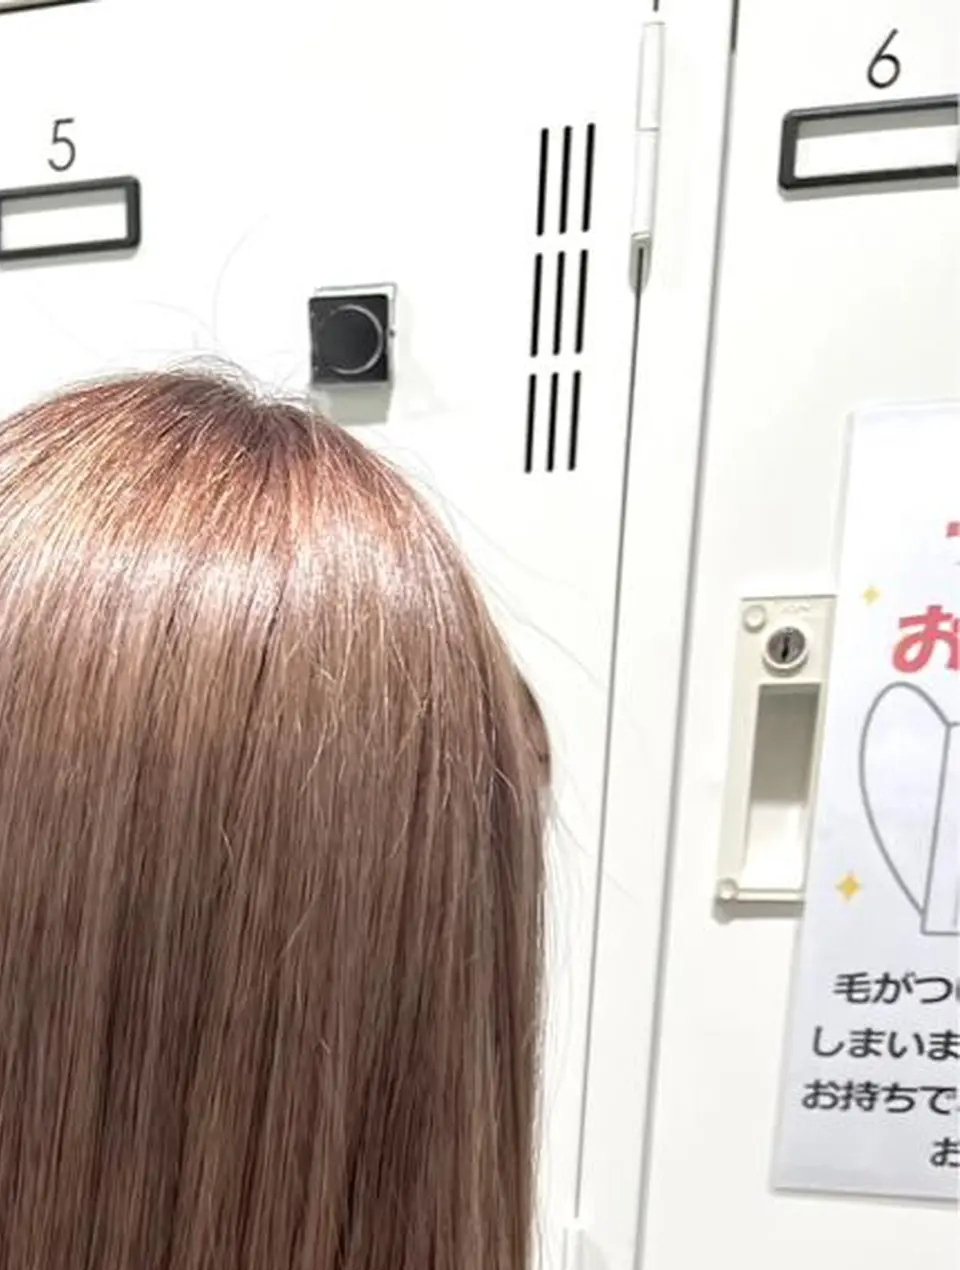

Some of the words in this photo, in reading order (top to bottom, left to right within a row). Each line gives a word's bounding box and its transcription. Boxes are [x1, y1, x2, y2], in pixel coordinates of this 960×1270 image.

[866, 28, 901, 89] 6
[47, 117, 76, 172] 5
[834, 972, 960, 1004] 毛がつ
